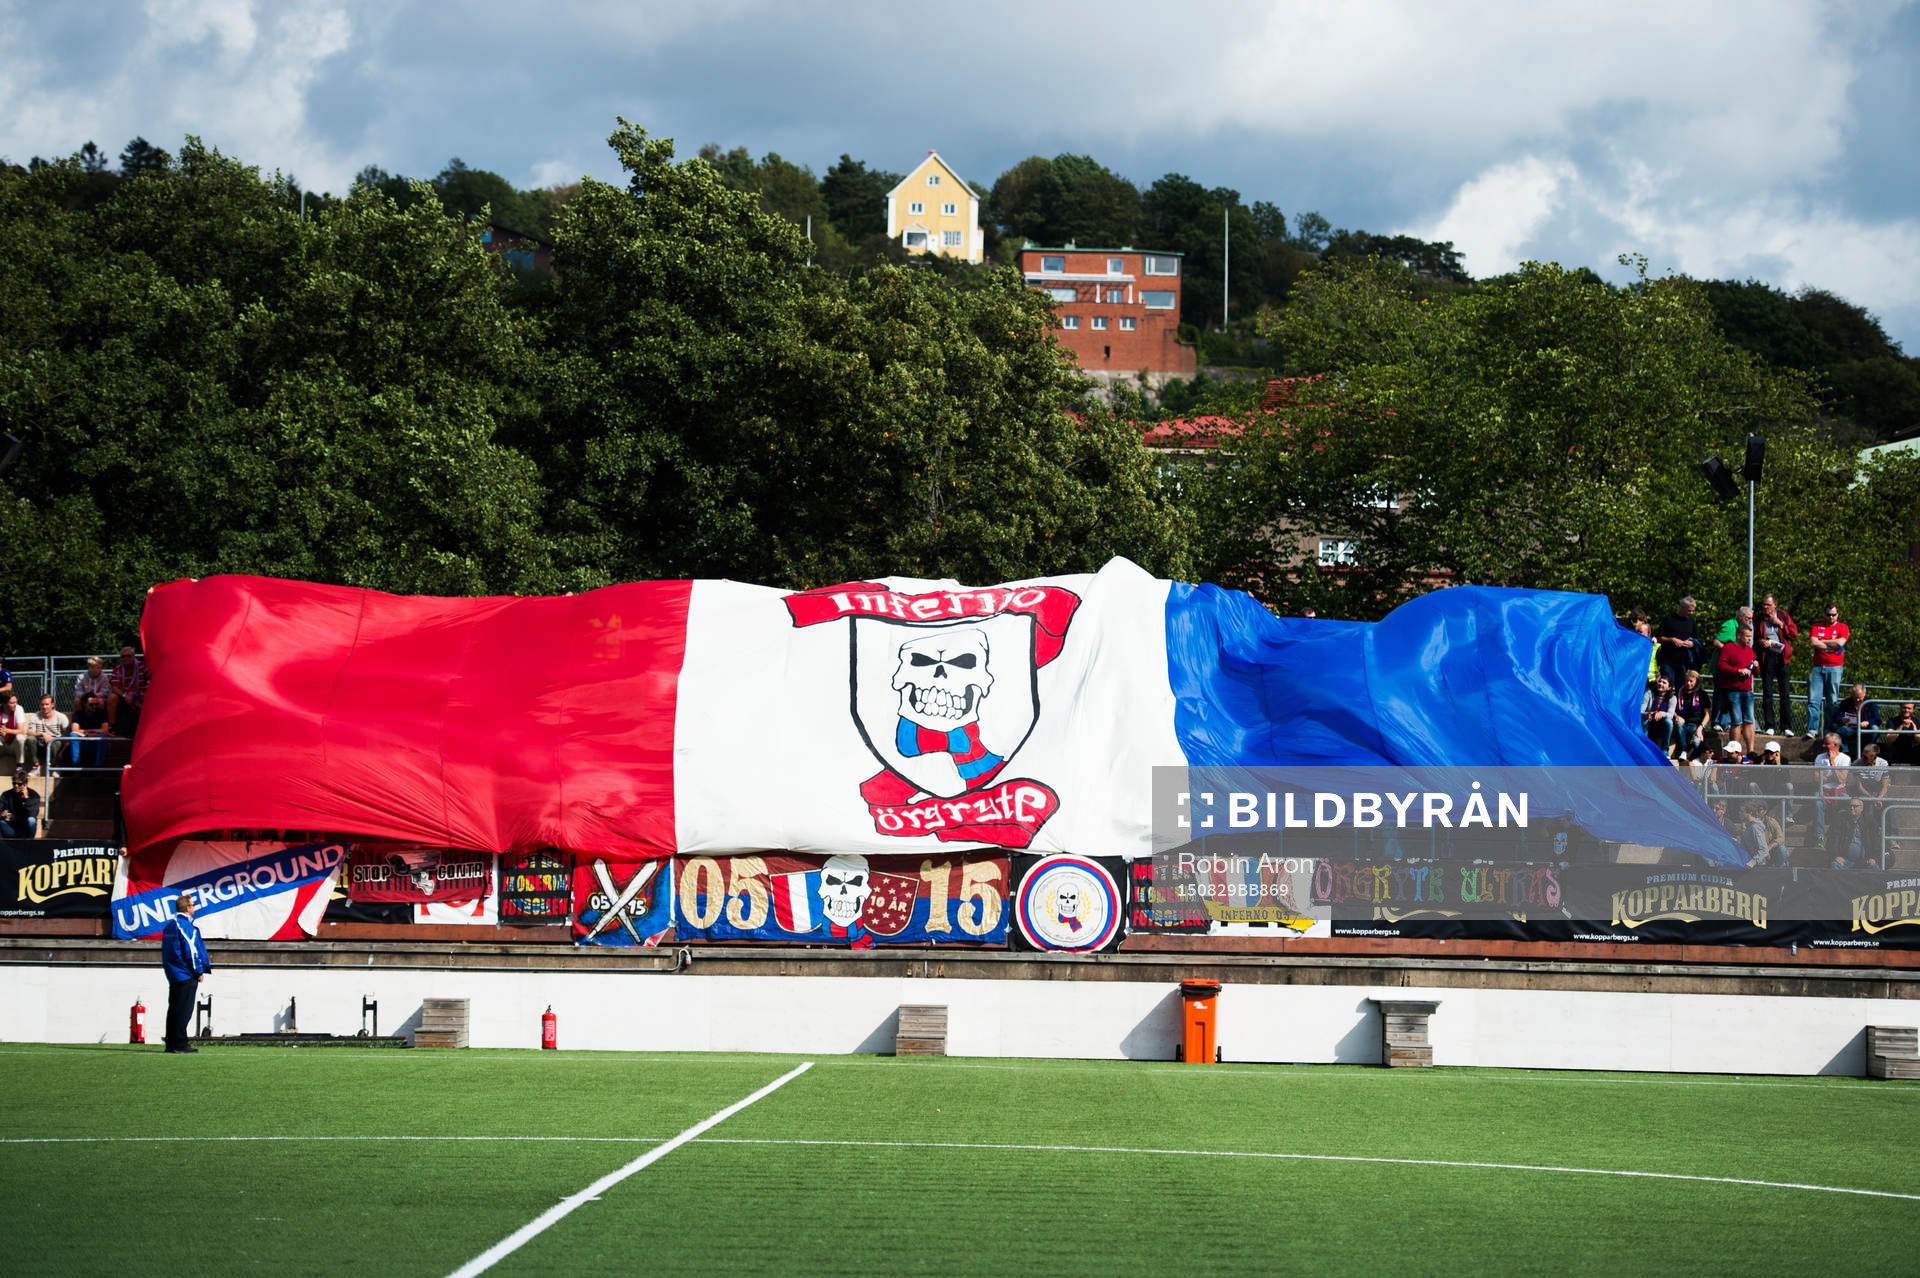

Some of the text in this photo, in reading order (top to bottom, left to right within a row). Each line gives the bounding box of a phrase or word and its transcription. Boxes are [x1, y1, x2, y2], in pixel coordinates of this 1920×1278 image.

[829, 590, 1046, 618] Inferno
[878, 785, 1047, 831] örgryte
[53, 847, 104, 858] PREMIUM
[353, 864, 391, 882] STOP
[1646, 873, 1733, 886] PREMIUM CIDER
[117, 844, 345, 932] UNDERGROUND
[502, 874, 571, 892] MODERNA
[1315, 858, 1561, 908] ÖRGRYTE ULTRAS
[679, 856, 1002, 935] 05 15
[870, 896, 908, 913] 10 ÅR
[502, 897, 569, 916] FOTBOLLEN
[590, 895, 646, 916] 05 15
[1611, 884, 1767, 929] KOPPARBERG
[1220, 910, 1268, 920] INFERNO
[1334, 928, 1400, 936] www.kopparbergs.se
[1573, 933, 1639, 942] www.kopparbergs.se
[1813, 939, 1880, 948] www.kopparbergs.se
